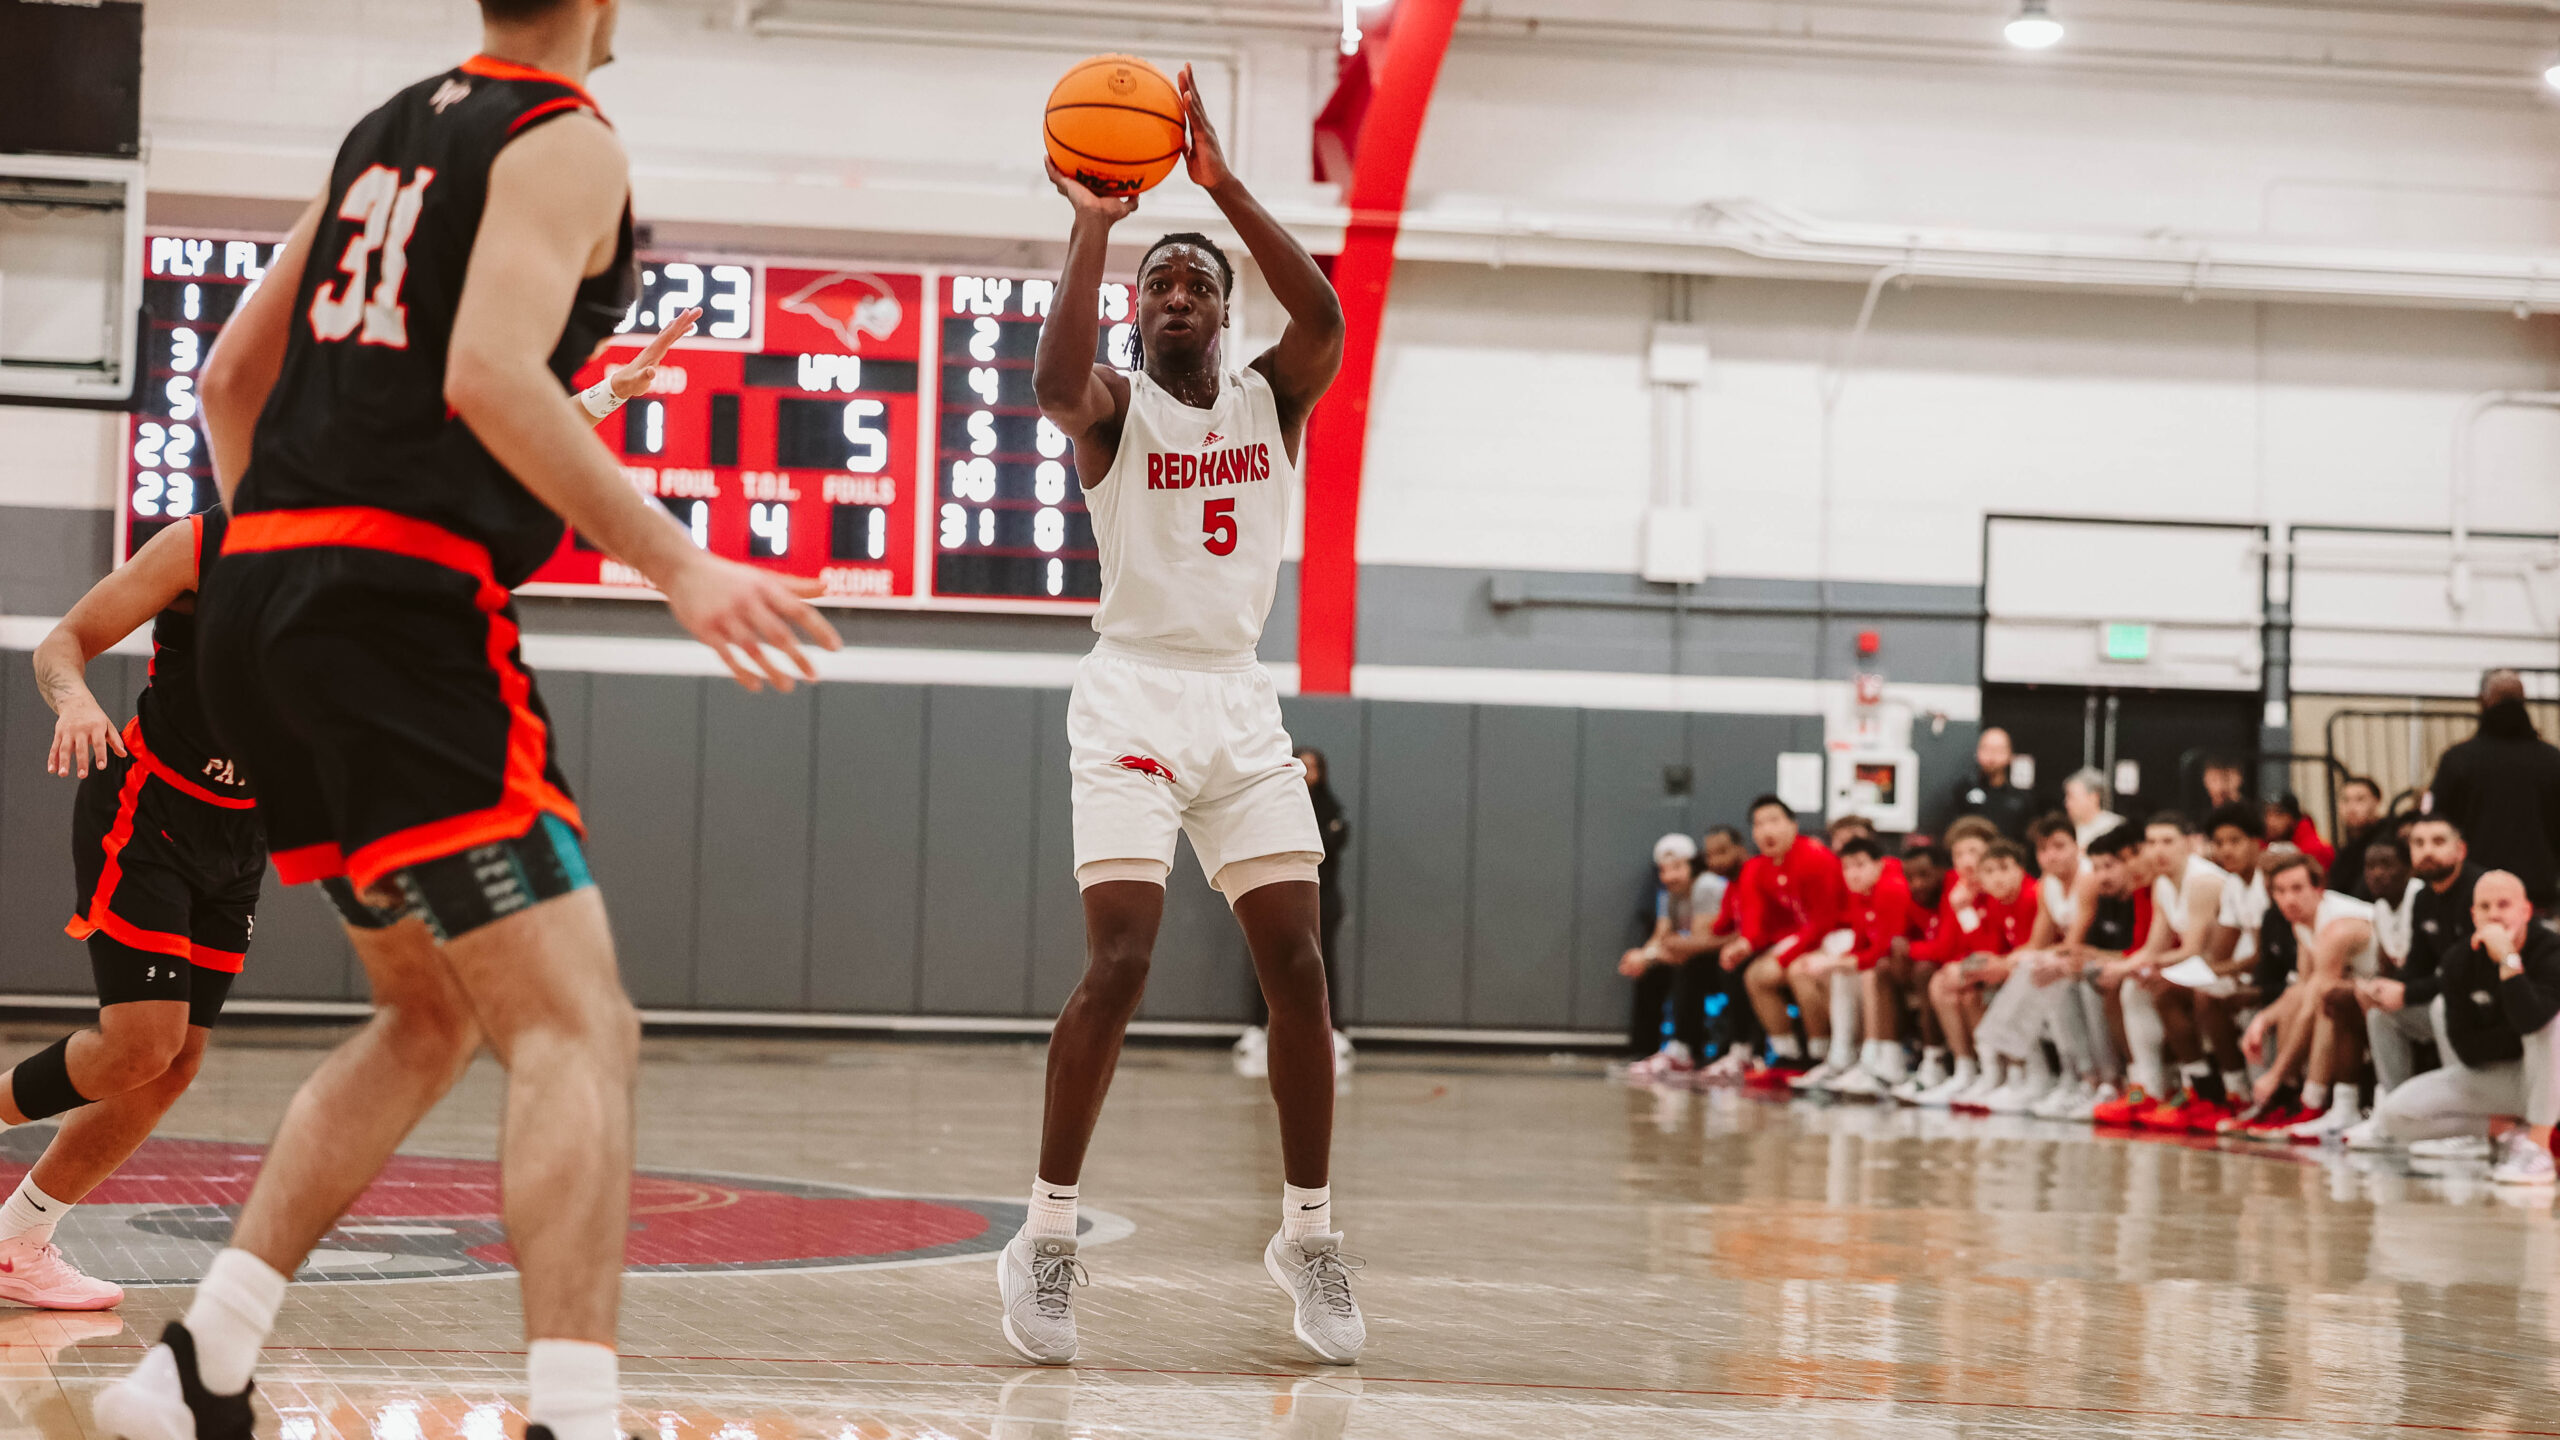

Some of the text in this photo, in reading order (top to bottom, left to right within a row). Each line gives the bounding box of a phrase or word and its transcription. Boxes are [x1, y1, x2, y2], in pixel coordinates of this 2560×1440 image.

[151, 237, 213, 277] PLY
[307, 163, 437, 350] 31
[184, 283, 200, 320] 1
[953, 276, 1012, 315] PLY
[171, 327, 198, 372] 3
[969, 317, 1000, 361] 2
[166, 375, 196, 420] 5
[968, 367, 999, 405] 4
[134, 422, 195, 469] 22
[646, 401, 664, 453] 1
[843, 399, 888, 473] 5
[967, 410, 997, 455] 5
[132, 471, 194, 517] 23
[750, 503, 789, 555] 4
[868, 507, 886, 559] 1
[1202, 497, 1238, 557] 5
[1047, 557, 1063, 596] 1
